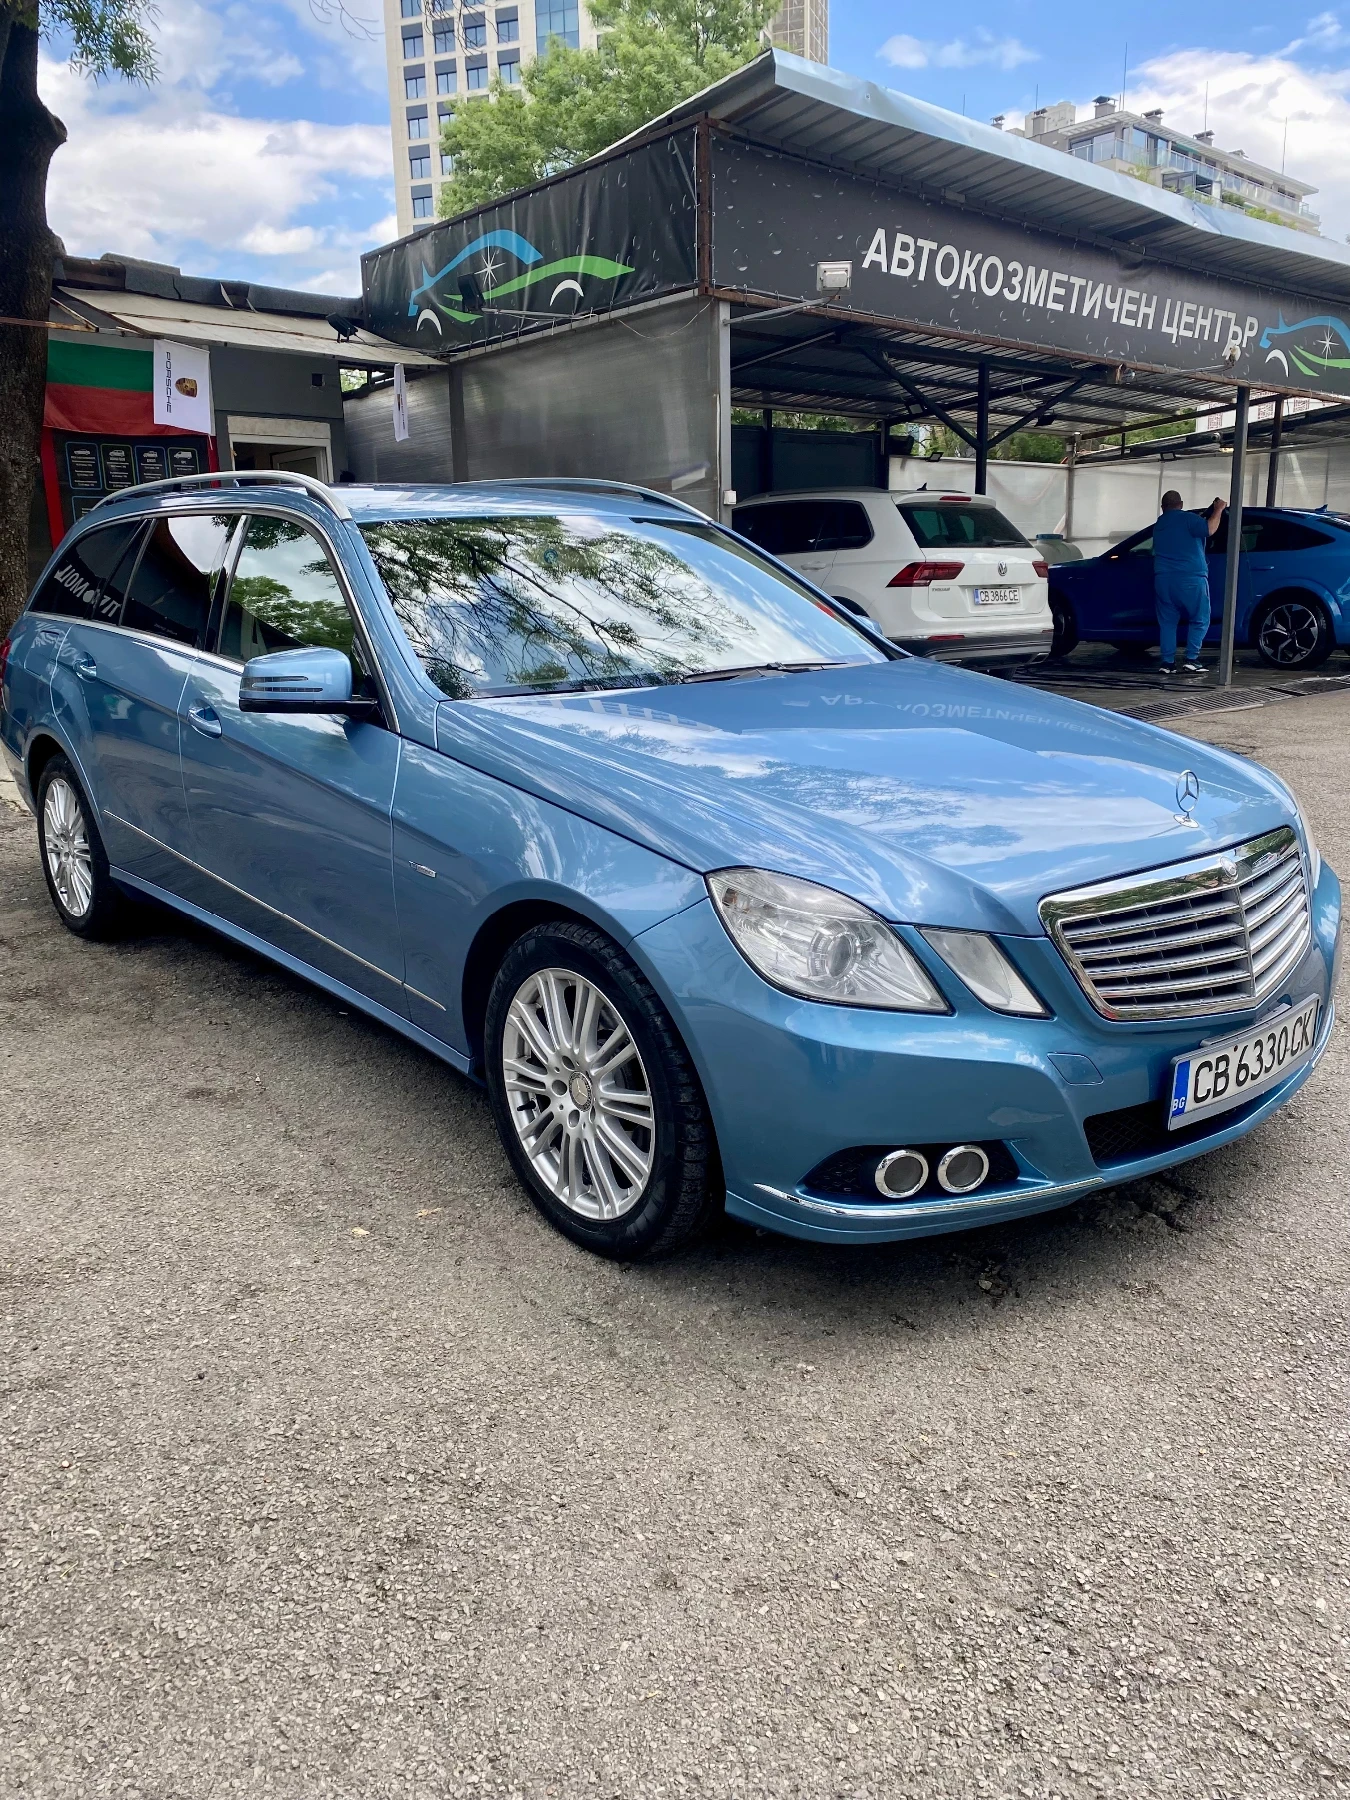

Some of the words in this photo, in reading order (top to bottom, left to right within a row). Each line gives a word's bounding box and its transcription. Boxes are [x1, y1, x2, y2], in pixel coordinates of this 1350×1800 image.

[862, 228, 1158, 330] АВТОКОЗМЕТИЧЕН
[1161, 298, 1259, 348] ЦЕНТЪР
[979, 590, 990, 602] CB
[991, 590, 1008, 602] 3866
[1009, 589, 1019, 601] CE
[1194, 1054, 1230, 1104] CB
[1236, 1026, 1288, 1087] 6330
[1290, 1008, 1314, 1057] CK
[1171, 1096, 1186, 1111] BG
